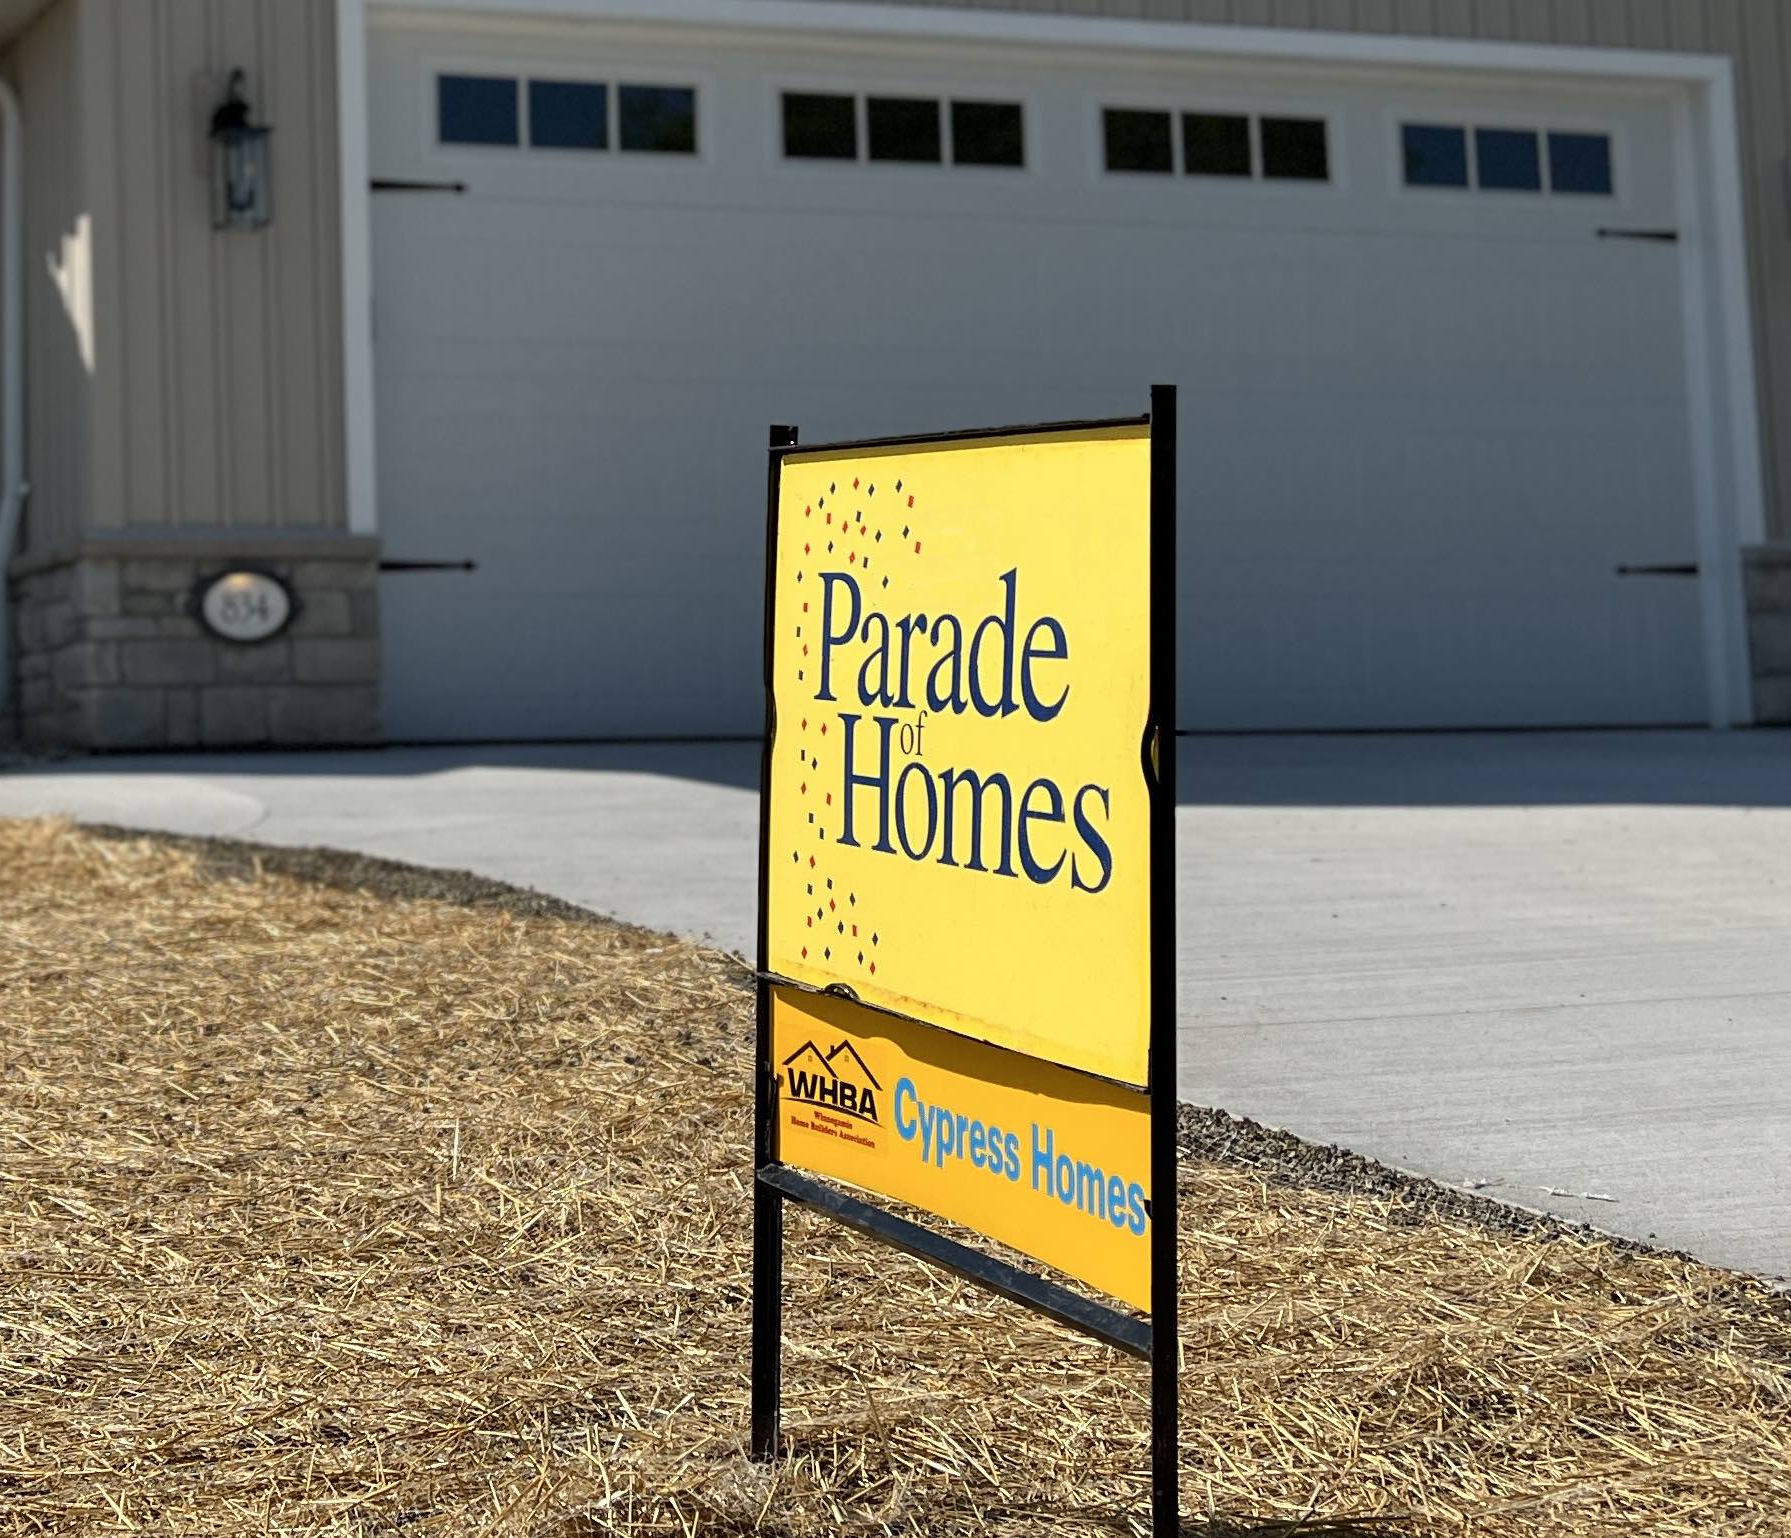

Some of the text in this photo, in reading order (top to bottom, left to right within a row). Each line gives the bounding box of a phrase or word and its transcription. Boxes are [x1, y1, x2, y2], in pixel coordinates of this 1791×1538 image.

[814, 567, 1070, 722] Parade
[900, 711, 928, 756] of
[836, 713, 1112, 894] Homes
[787, 1067, 879, 1123] WHBA
[791, 1115, 875, 1148] Home Builders Association
[894, 1077, 1147, 1236] Cypress Homes
